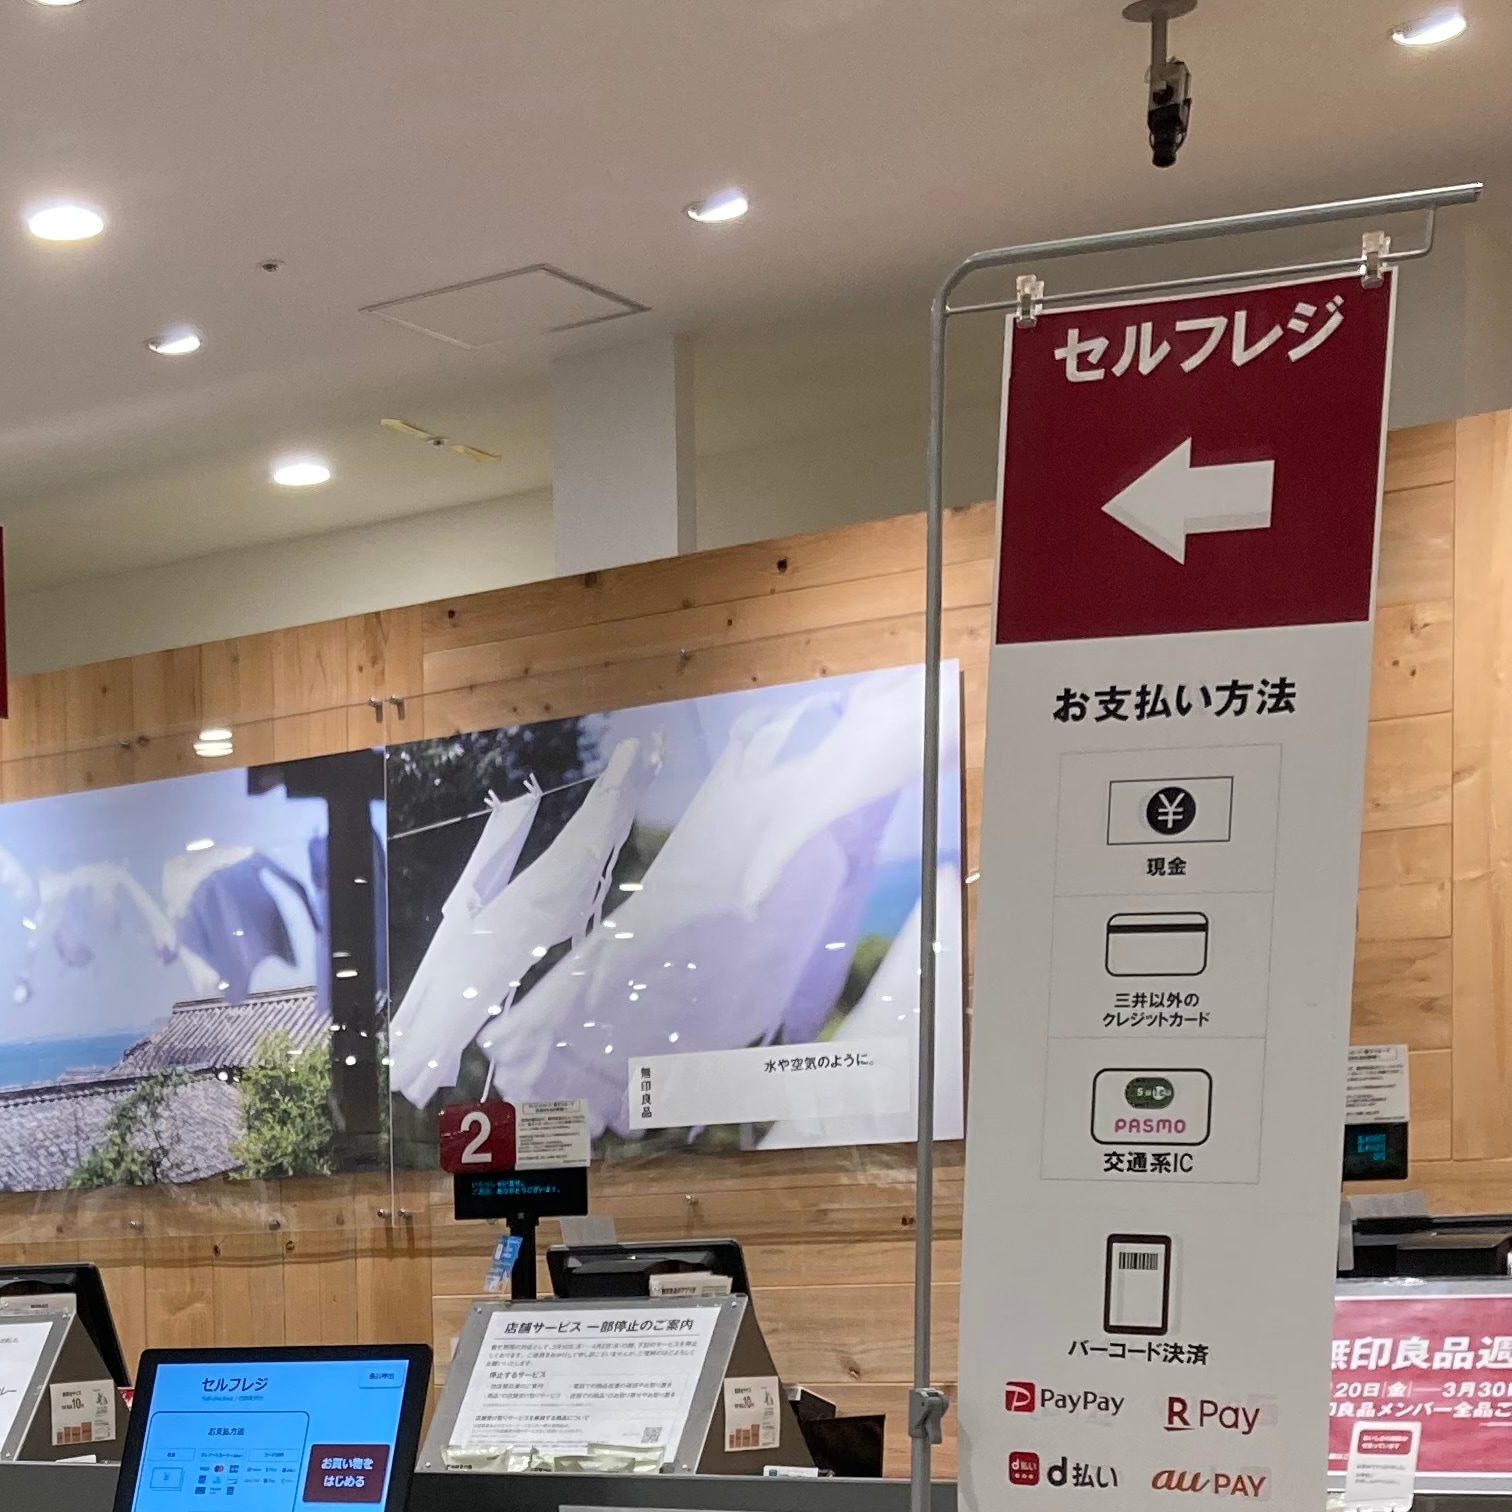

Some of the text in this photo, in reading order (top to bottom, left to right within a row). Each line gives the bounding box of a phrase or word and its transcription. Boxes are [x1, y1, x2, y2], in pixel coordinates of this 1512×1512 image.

[1053, 294, 1345, 383] セルフレジ
[1052, 676, 1298, 723] お支払い方法
[1146, 856, 1188, 877] 現金
[1113, 991, 1200, 1009] 三井以外の
[1101, 1011, 1212, 1028] クレジットカード
[763, 1053, 875, 1073] 水や空気のように。
[640, 1066, 653, 1119] 無印良品
[1114, 1118, 1186, 1134] PASMO
[460, 1111, 492, 1164] 2
[1103, 1152, 1195, 1174] 交通系IC
[504, 1319, 694, 1334] 店舗サービス 一部停止のご案内
[1067, 1340, 1210, 1366] バーコード決済
[201, 1376, 269, 1393] セルフレジ
[1040, 1387, 1125, 1415] PayPay
[1164, 1396, 1261, 1435] R Pay
[321, 1458, 374, 1470] お買い物を
[1046, 1456, 1119, 1489] d払い
[323, 1475, 365, 1488] はじめる
[1151, 1469, 1267, 1498] au PAY
